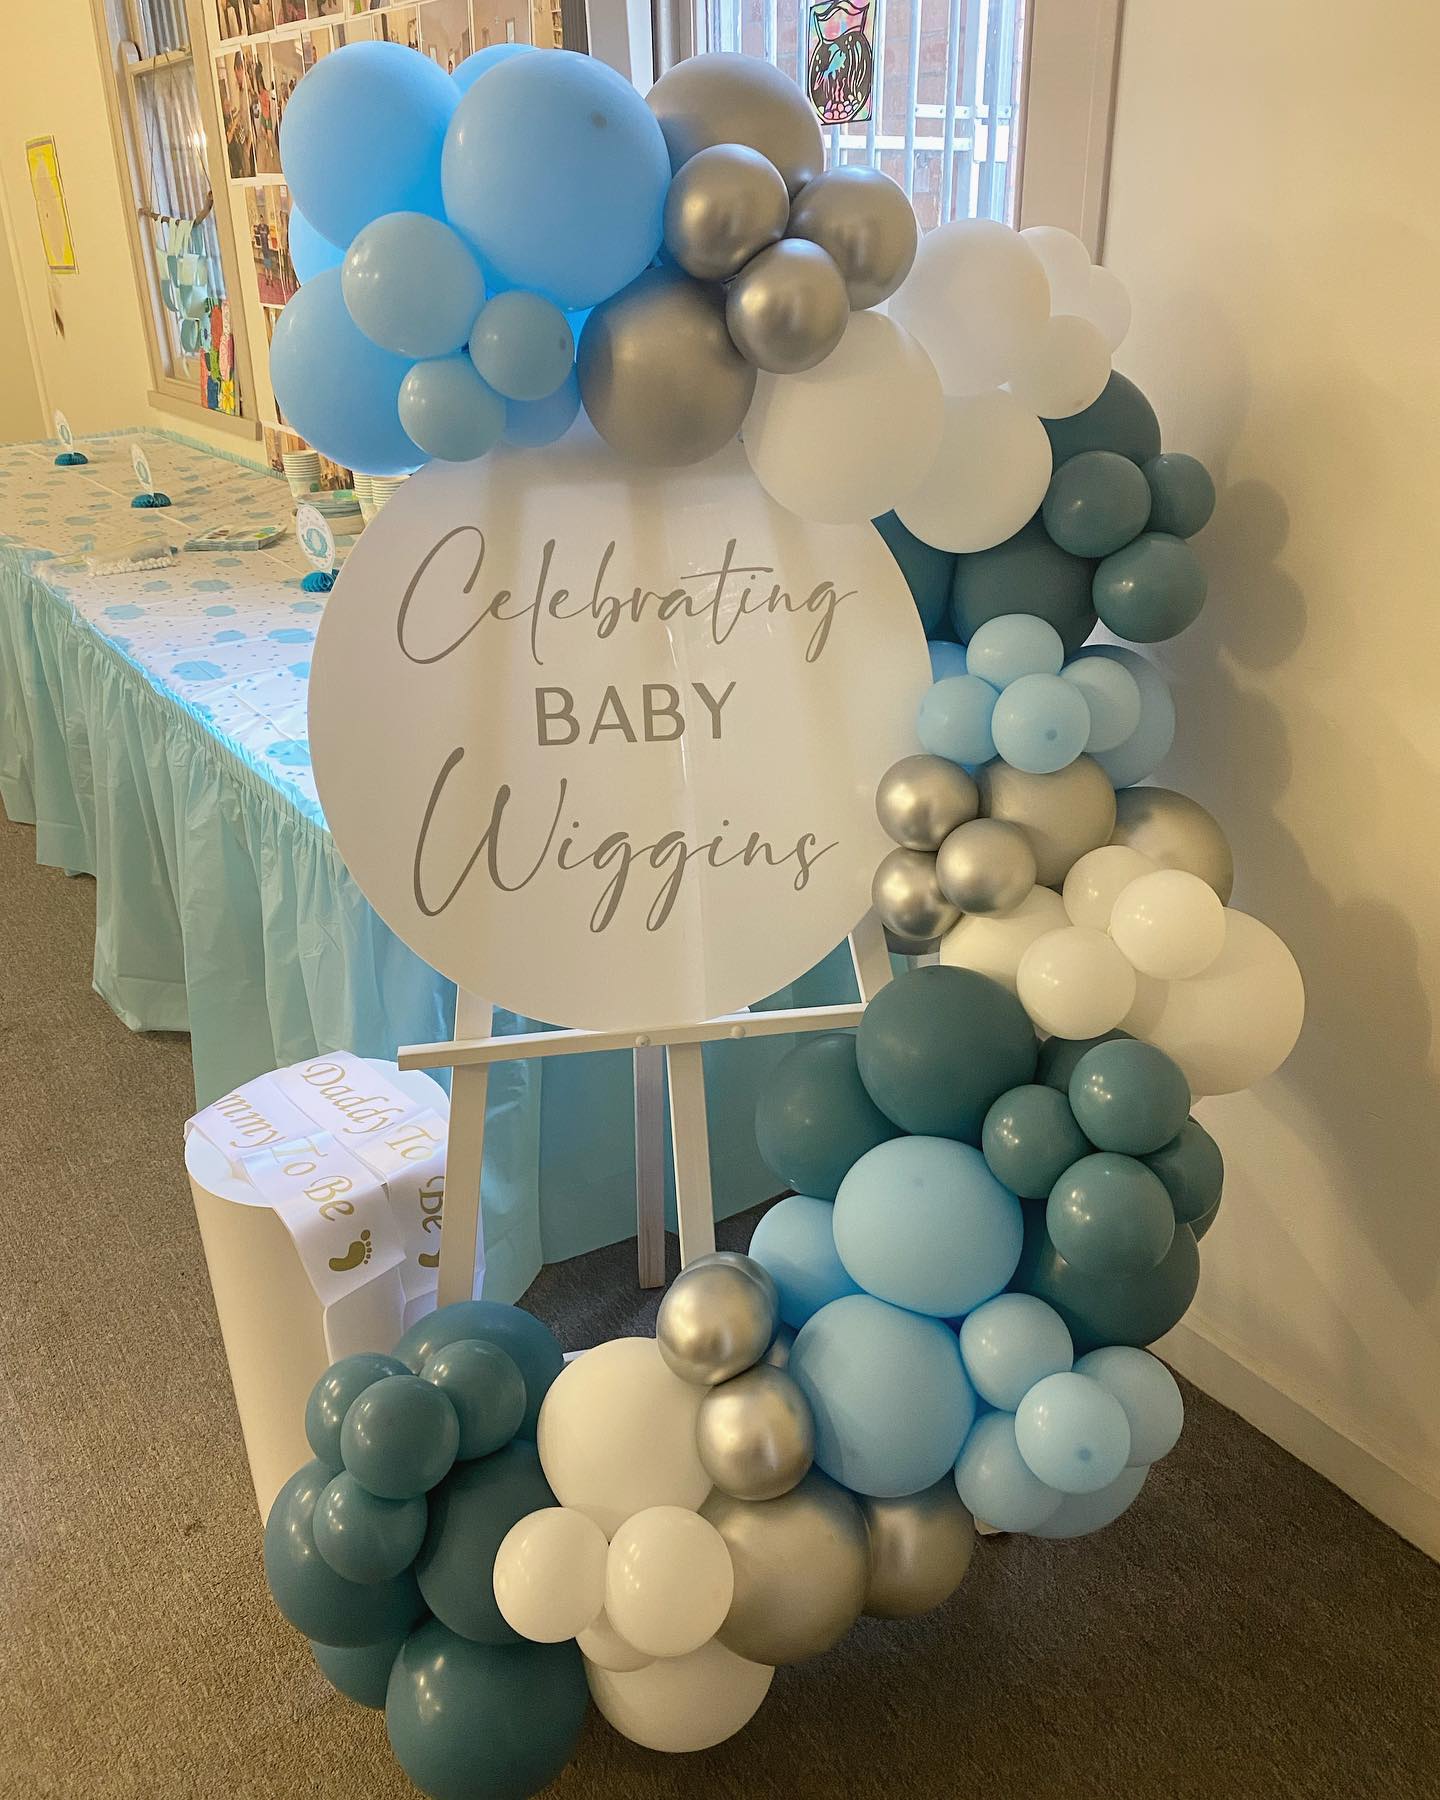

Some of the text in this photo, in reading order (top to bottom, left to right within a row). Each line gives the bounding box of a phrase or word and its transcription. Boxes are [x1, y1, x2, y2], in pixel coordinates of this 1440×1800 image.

[397, 526, 859, 665] Celebrating
[534, 681, 737, 746] BABY
[413, 747, 839, 933] Wiggins
[301, 1062, 405, 1134] Daddy
[384, 1125, 441, 1160] To
[271, 1136, 329, 1176] To
[302, 1175, 355, 1221] Be
